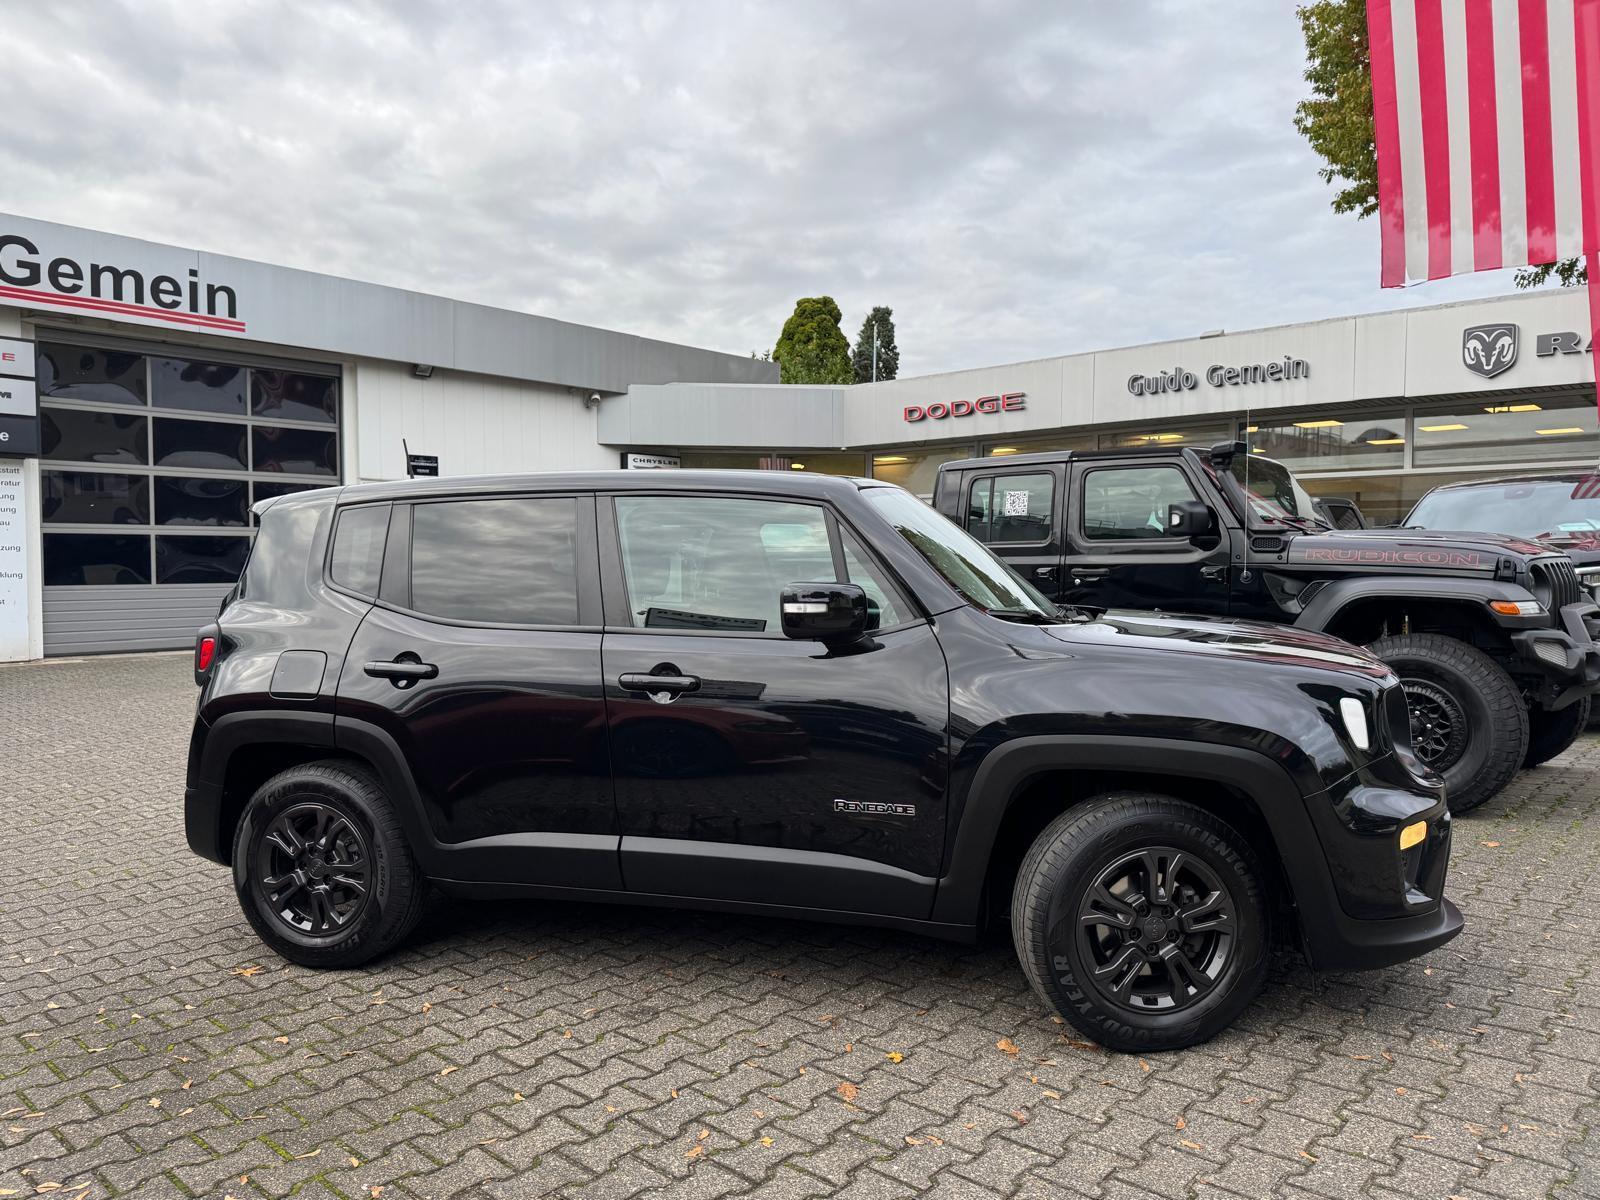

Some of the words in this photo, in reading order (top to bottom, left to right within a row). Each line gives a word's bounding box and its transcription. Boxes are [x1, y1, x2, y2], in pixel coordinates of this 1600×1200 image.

[0, 235, 237, 319] Gemein
[1536, 332, 1593, 357] R
[1128, 367, 1196, 396] Guido
[1206, 355, 1309, 387] Gemein
[903, 391, 1026, 422] DODGE
[632, 457, 678, 466] CHRYSLER
[1304, 547, 1480, 567] RUBICON
[834, 799, 915, 816] RENEGADE
